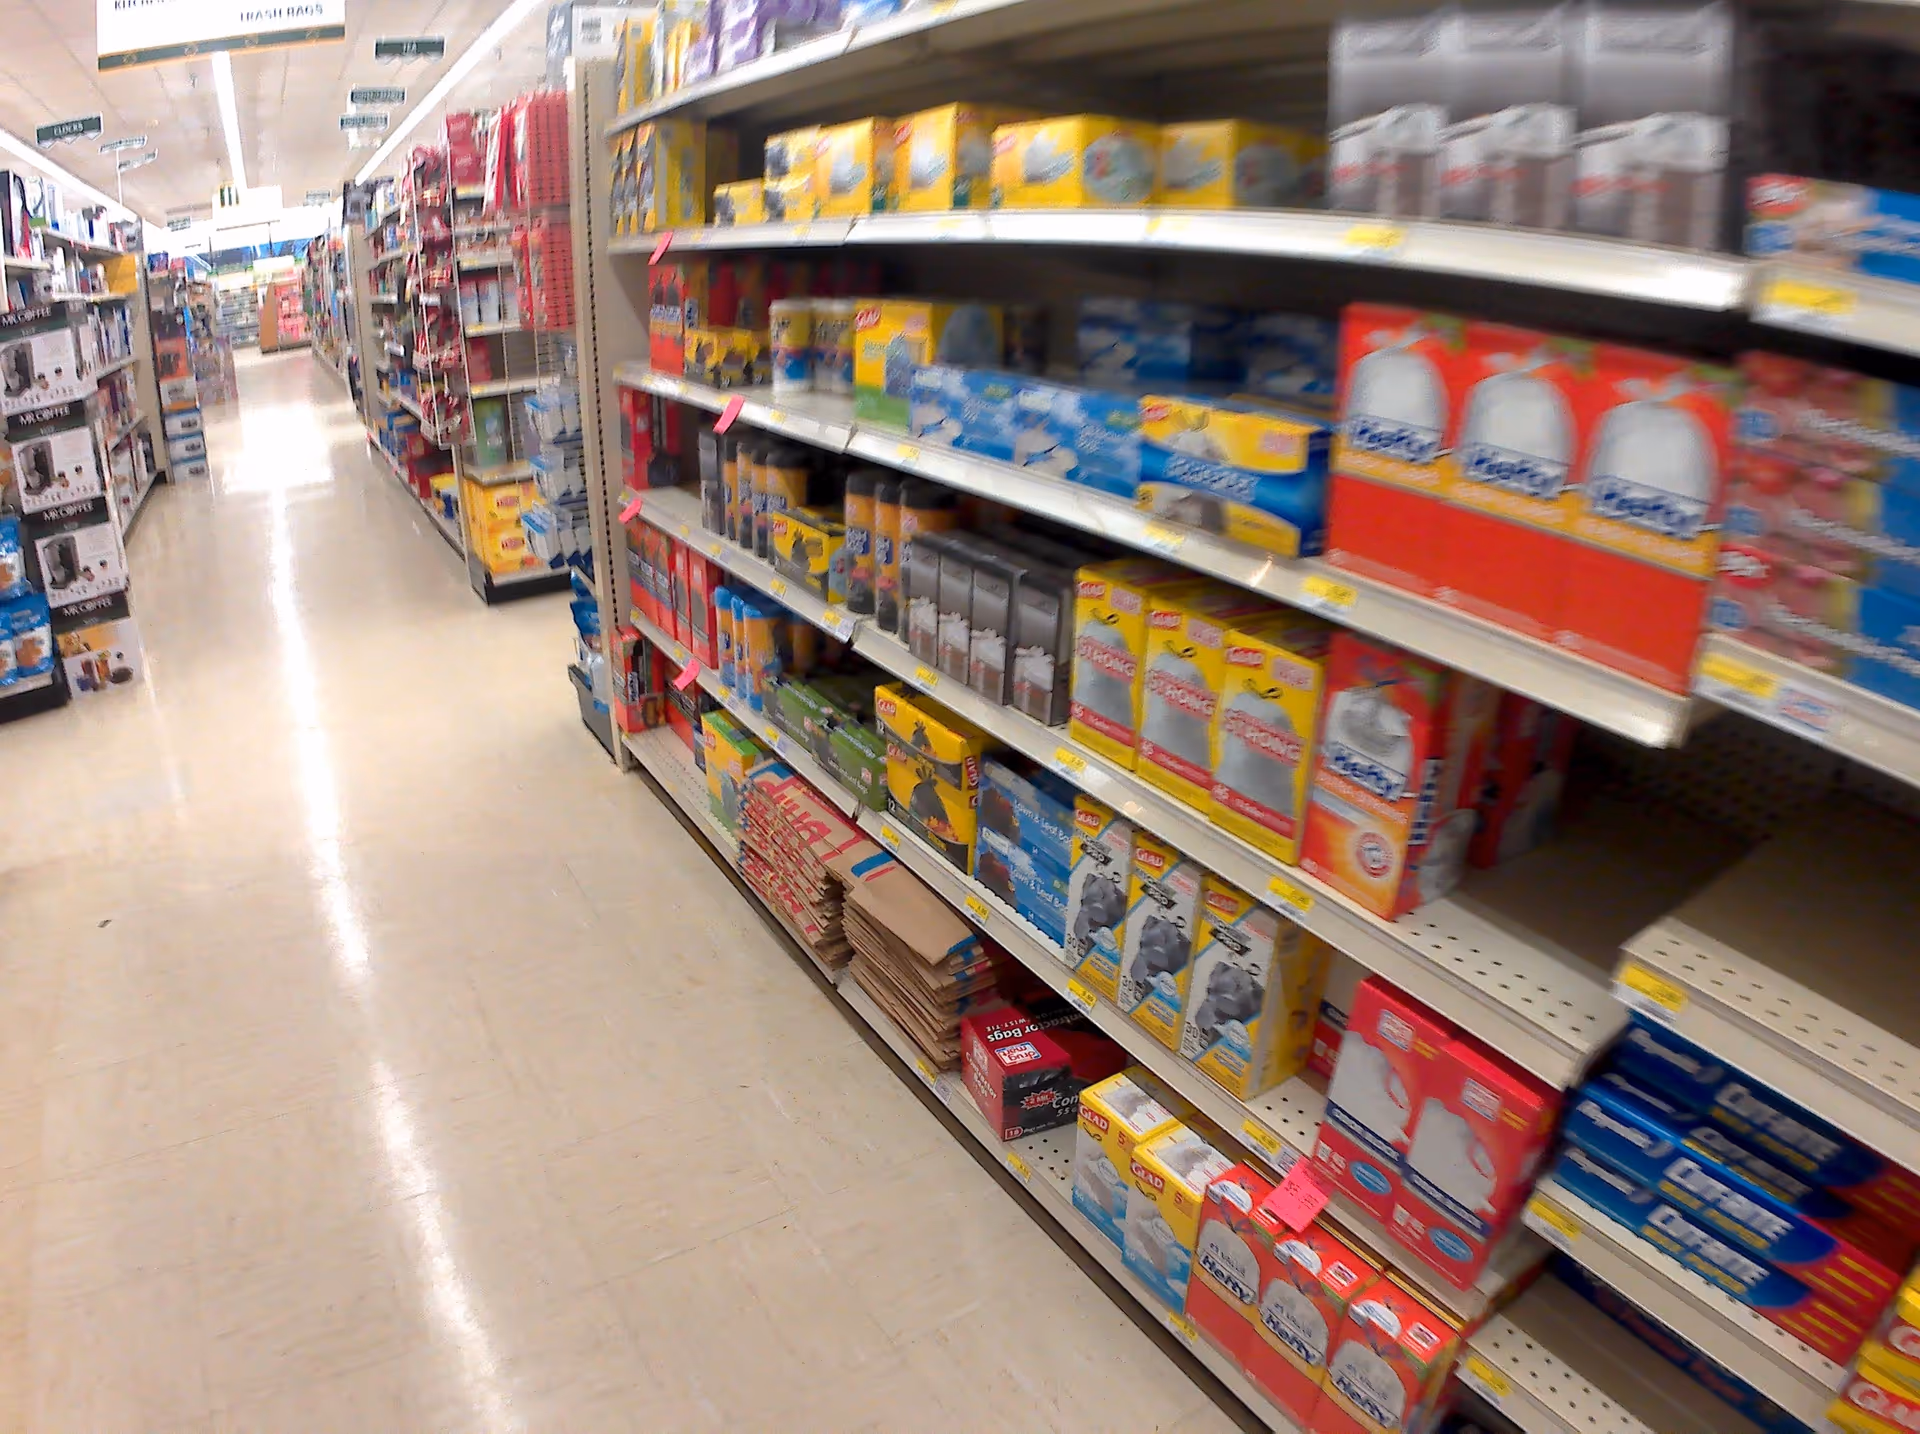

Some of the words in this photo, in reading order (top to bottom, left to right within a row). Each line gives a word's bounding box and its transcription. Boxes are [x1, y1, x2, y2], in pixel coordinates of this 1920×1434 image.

[240, 9, 284, 22] TRASH
[286, 4, 324, 17] BAGS
[878, 699, 896, 714] GLAD
[966, 757, 979, 786] GLAD
[1076, 808, 1100, 827] GLAD
[1136, 847, 1164, 867] GLAD
[1067, 933, 1077, 949] 30
[1123, 975, 1133, 992] 30
[987, 1027, 1023, 1042] Bags
[1186, 1021, 1199, 1039] 30
[1001, 1044, 1028, 1057] mart
[1008, 1050, 1036, 1062] drug
[1052, 1094, 1078, 1109] Con
[1079, 1106, 1108, 1130] GLAD
[1131, 1162, 1165, 1189] GLAD
[1202, 1255, 1248, 1302] Hefty
[1265, 1314, 1316, 1365] Hefty
[1336, 1377, 1391, 1422] Hefty
